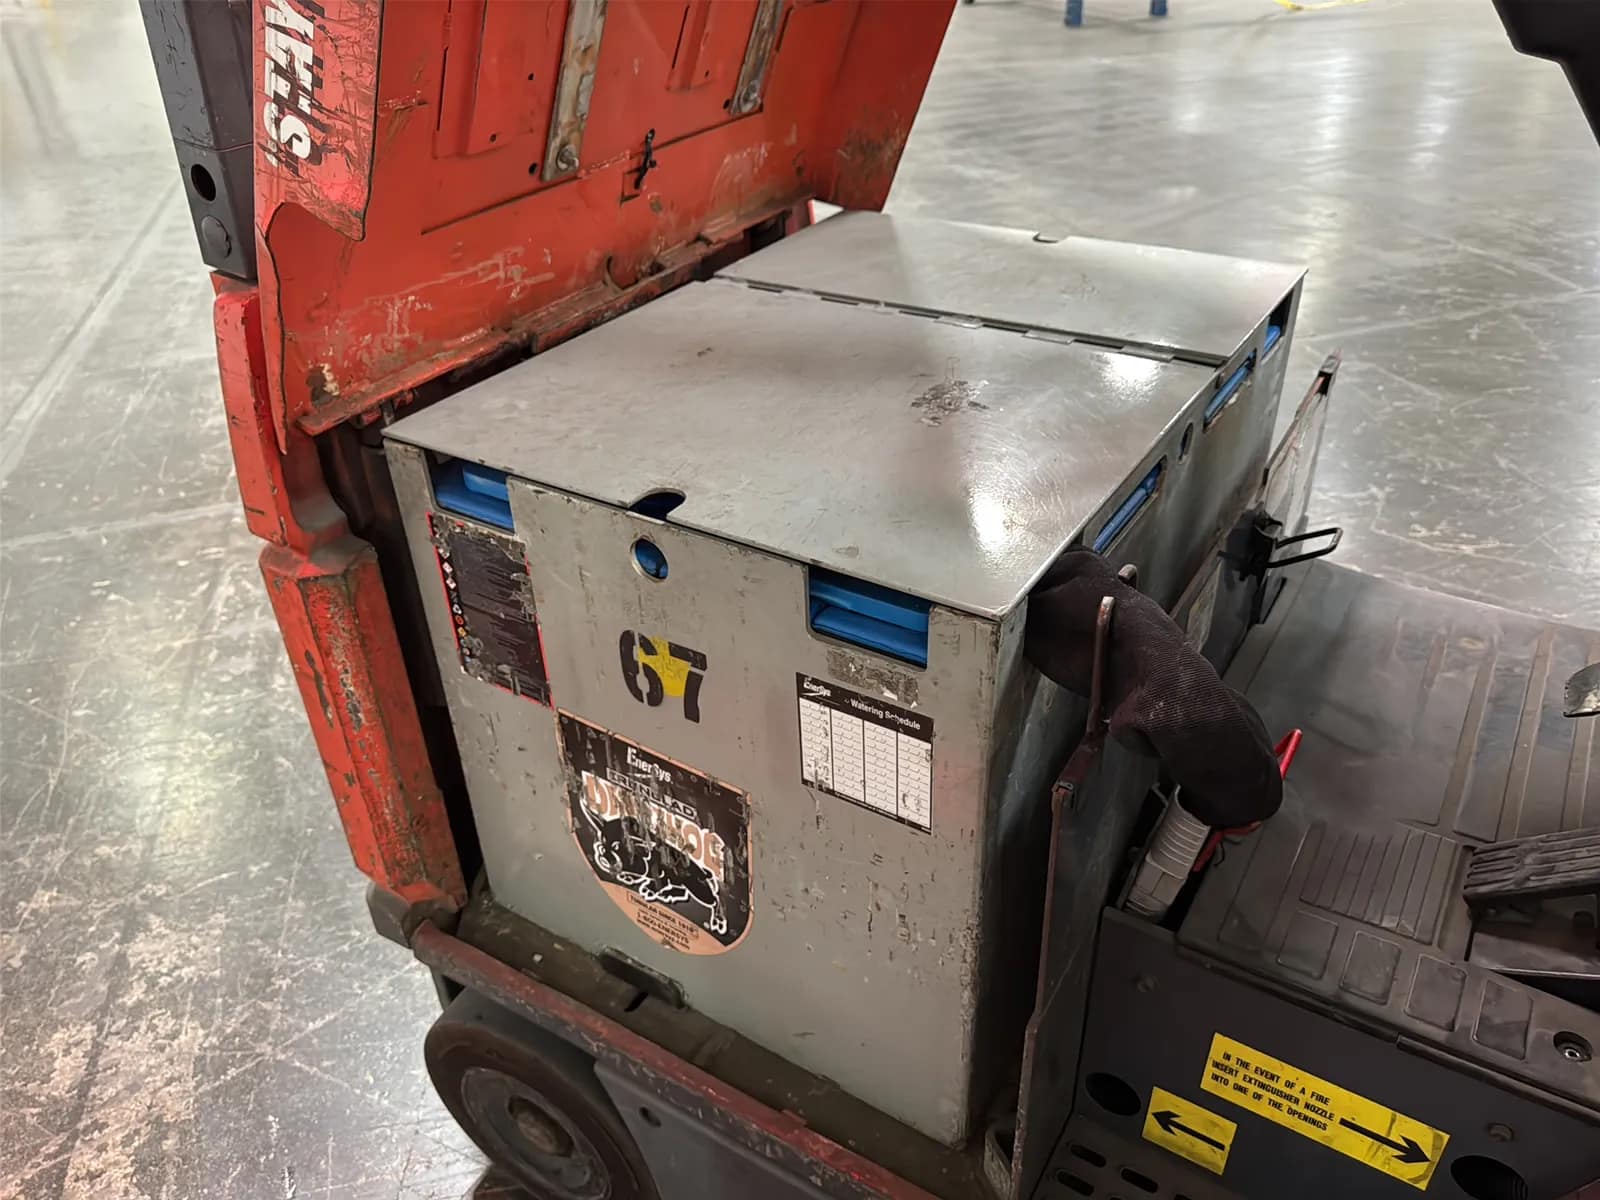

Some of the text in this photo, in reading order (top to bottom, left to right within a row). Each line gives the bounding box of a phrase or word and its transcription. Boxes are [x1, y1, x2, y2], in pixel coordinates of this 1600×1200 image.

[618, 629, 708, 724] 67
[850, 698, 921, 730] Watering Schedule
[626, 745, 672, 783] EnerSys
[1210, 1072, 1327, 1131] INTO ONE OF THE OPENINGS
[1211, 1060, 1336, 1122] INSERT EXTINGUISHER NOZZLE
[1222, 1051, 1331, 1106] IN THE EVENT OF A FIRE
